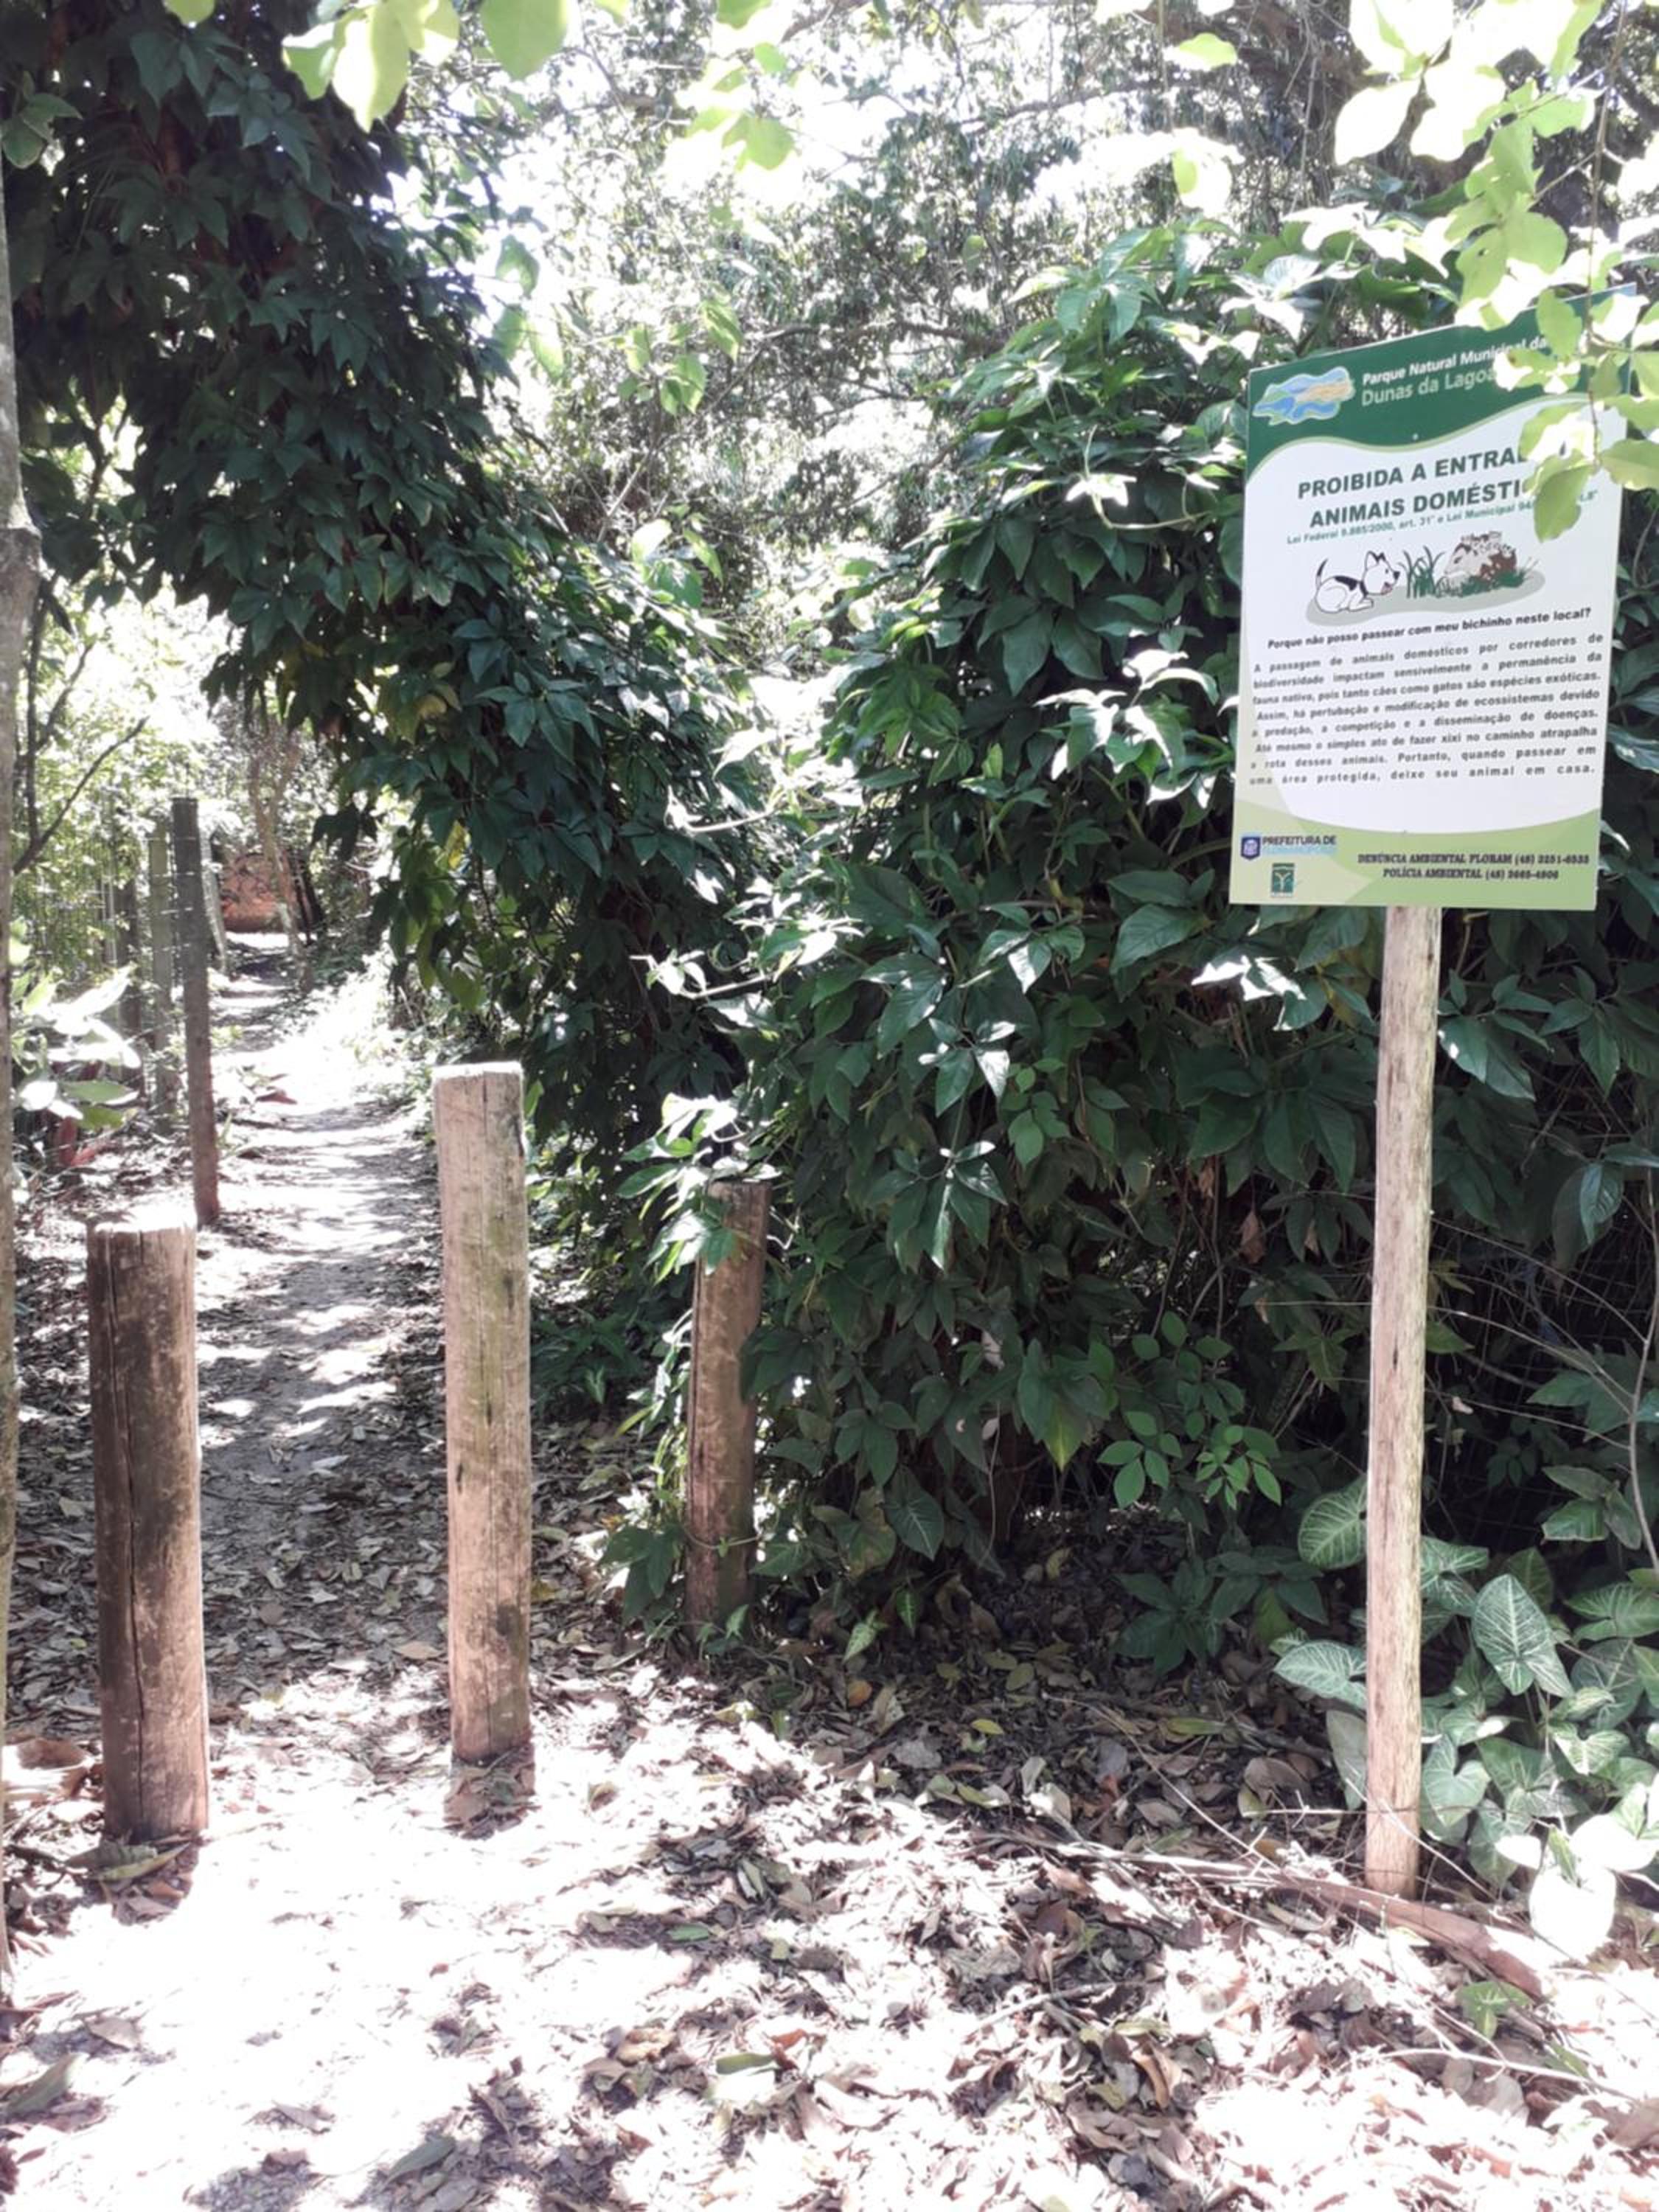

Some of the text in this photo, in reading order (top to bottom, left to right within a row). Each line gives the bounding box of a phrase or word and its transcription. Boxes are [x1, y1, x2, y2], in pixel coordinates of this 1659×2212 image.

[1363, 367, 1405, 385] Parque
[1409, 355, 1456, 375] Natural
[1530, 337, 1547, 349] da
[1362, 383, 1413, 406] Dunas
[1417, 378, 1439, 394] da
[1298, 467, 1402, 498] PROIBIDA
[1411, 463, 1426, 481] A
[1287, 535, 1301, 544] Lei
[1399, 518, 1416, 529] art.
[1446, 512, 1461, 522] Lei
[1310, 498, 1404, 528] ANIMAIS
[1267, 608, 1591, 649] Porque não posso passear com meu bichinho neste local?
[1253, 633, 1603, 672] A passagem de animais domésticos por corredores de
[1253, 652, 1601, 689] biodiversidade impactam sensivelmente a permanência da
[1251, 672, 1601, 705] fauna nativa, pois tanto cães como gatos são espécies exóticas.
[1255, 711, 1288, 720] Assim,
[1293, 709, 1306, 718] há
[1310, 704, 1368, 719] pertubação
[1384, 698, 1450, 712] modificação
[1454, 698, 1469, 707] de
[1474, 693, 1554, 706] ecossistemas
[1559, 689, 1600, 700] devido
[1251, 729, 1258, 737] a
[1265, 725, 1312, 737] predação,
[1321, 725, 1327, 733] a
[1335, 719, 1396, 732] competição
[1419, 719, 1425, 727] a
[1433, 712, 1511, 726] disseminação
[1520, 711, 1534, 721] de
[1543, 709, 1598, 720] doenças.
[1255, 743, 1271, 753] Até
[1276, 742, 1311, 751] mesmo
[1326, 738, 1366, 750] simples
[1370, 737, 1387, 747] ato
[1391, 736, 1405, 745] de
[1409, 734, 1436, 745] fazer
[1441, 732, 1461, 743] xixi
[1466, 733, 1480, 742] no
[1484, 728, 1534, 741] caminho
[1540, 726, 1597, 740] atrapalha
[1265, 759, 1286, 768] rota
[1295, 757, 1332, 767] desses
[1341, 754, 1387, 765] animais.
[1397, 751, 1450, 762] Portanto,
[1461, 748, 1505, 761] quando
[1515, 747, 1566, 759] passear
[1576, 745, 1596, 755] em
[1249, 764, 1594, 785] uma área protegida, deixe seu animal em casa.
[1263, 835, 1337, 845] PREFEITURA DE
[1358, 852, 1407, 863] DENÚNCIA
[1410, 854, 1464, 864] AMBIENTAL
[1469, 854, 1512, 864] FLORAM
[1382, 867, 1421, 877] POLÍCIA
[1425, 869, 1481, 878] AMBIENTAL
